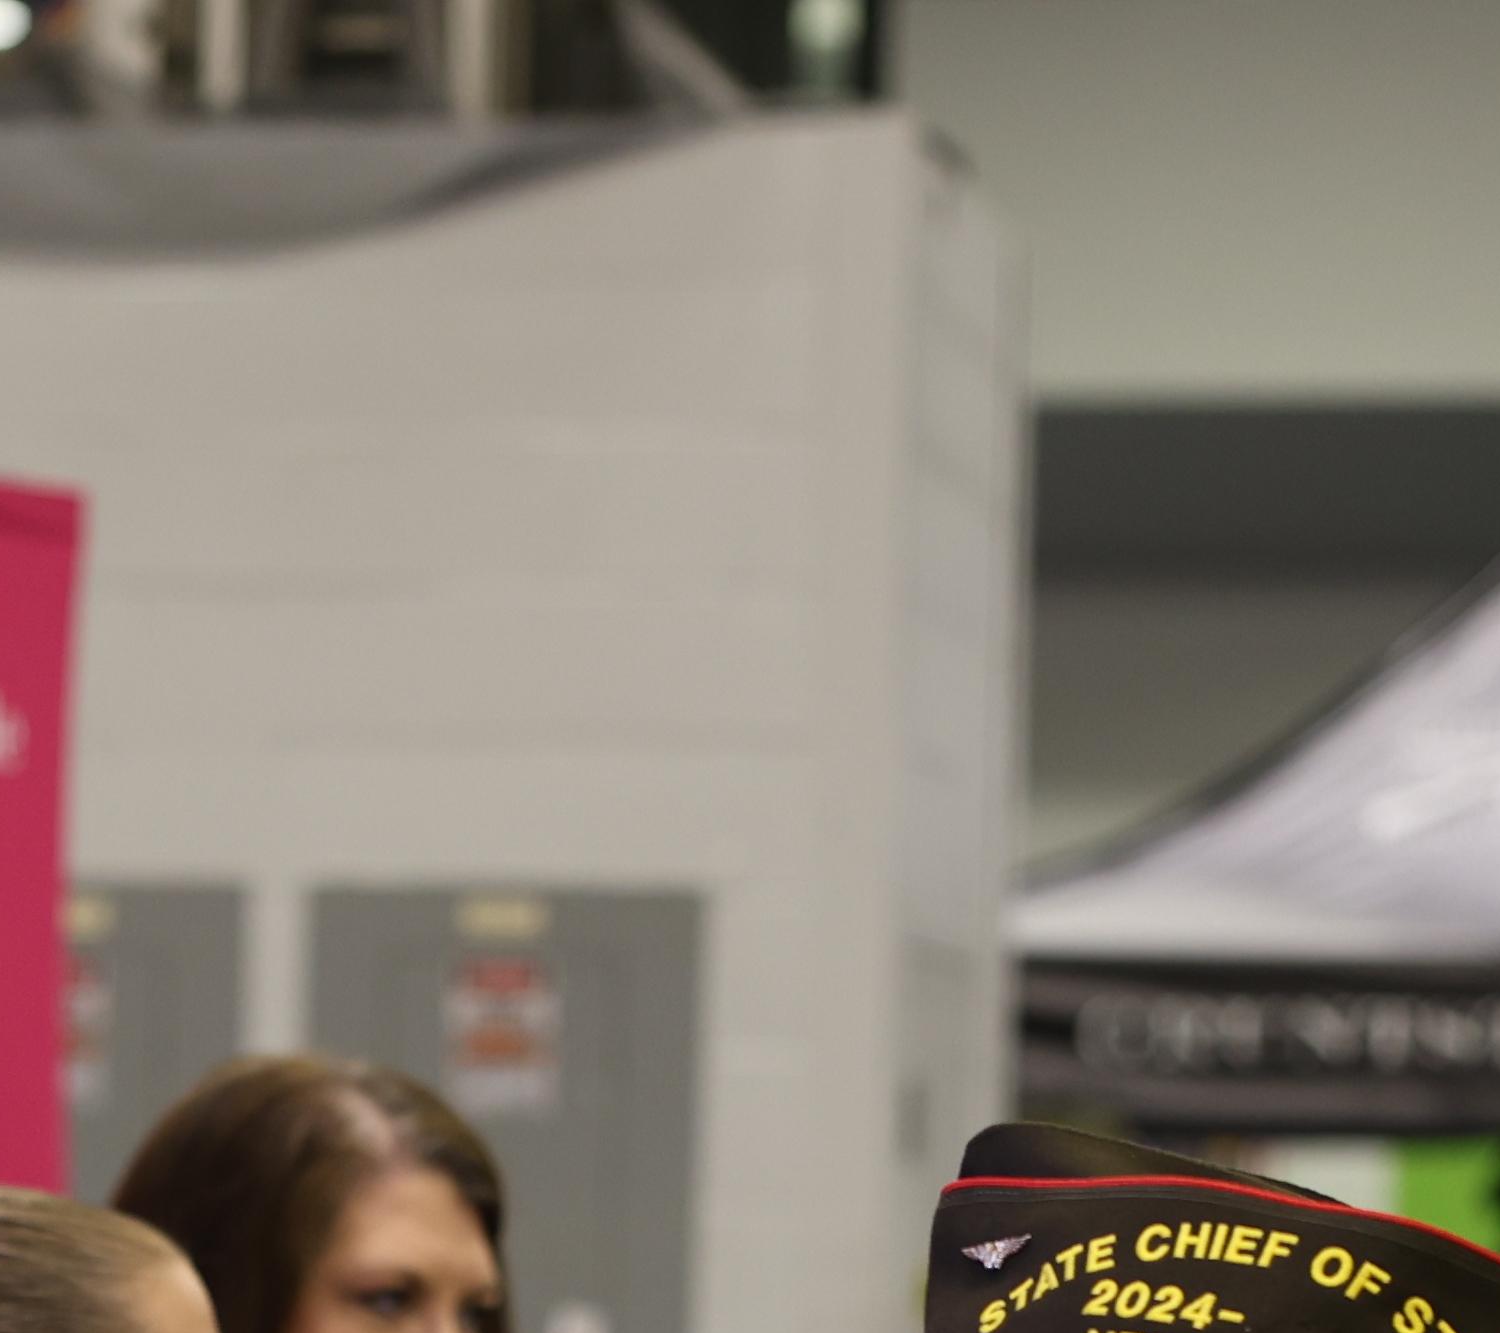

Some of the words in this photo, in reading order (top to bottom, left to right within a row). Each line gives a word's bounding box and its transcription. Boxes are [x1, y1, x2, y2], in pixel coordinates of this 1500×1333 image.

[1134, 1221, 1300, 1267] CHIEF
[1310, 1245, 1393, 1302] OF
[1080, 1279, 1246, 1331] 2024-
